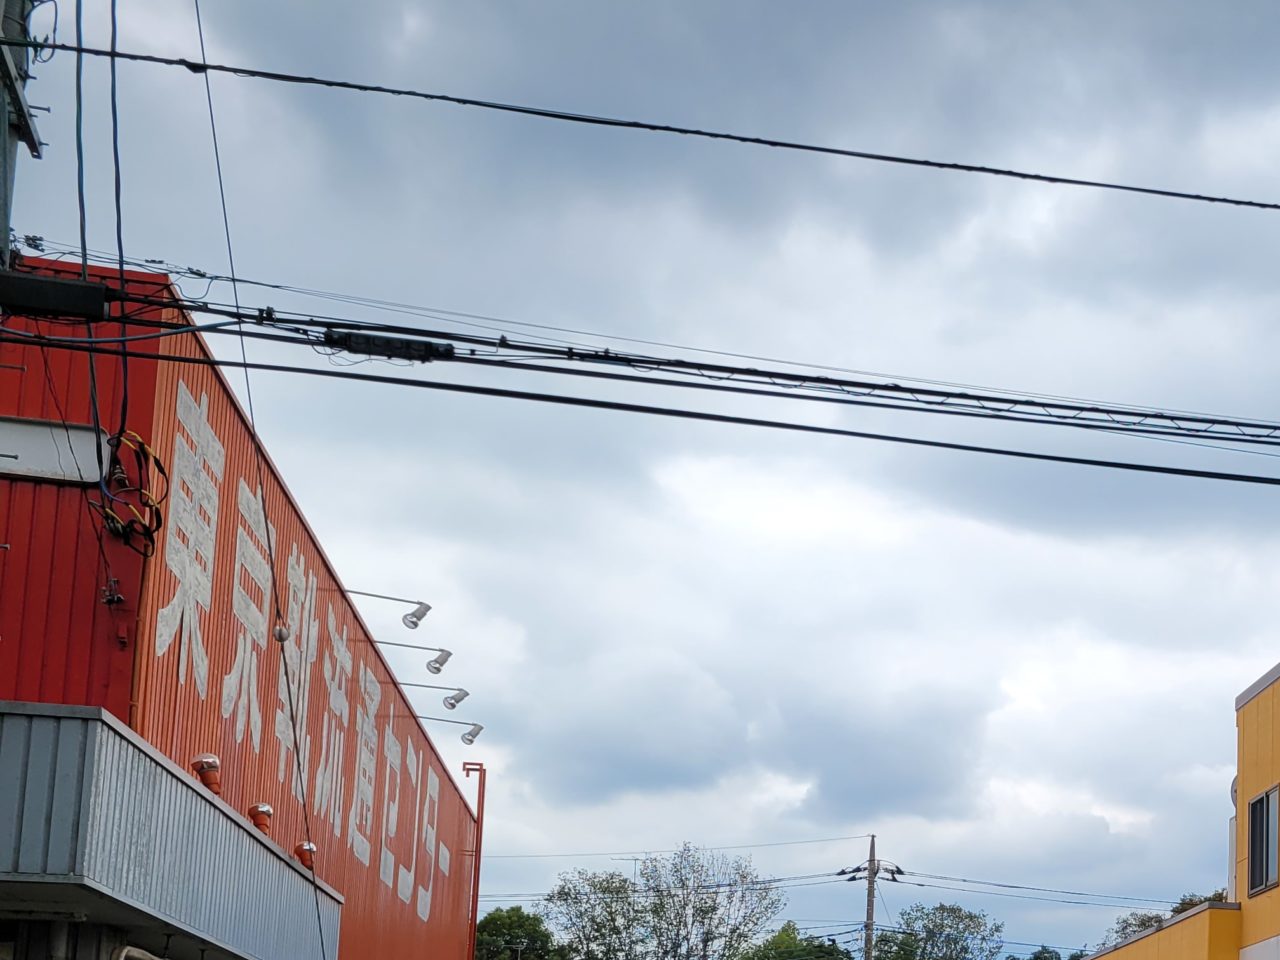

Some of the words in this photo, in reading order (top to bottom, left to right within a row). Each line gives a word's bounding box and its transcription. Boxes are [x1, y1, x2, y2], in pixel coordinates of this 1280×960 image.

[155, 379, 450, 922] 東京靴流通センター
